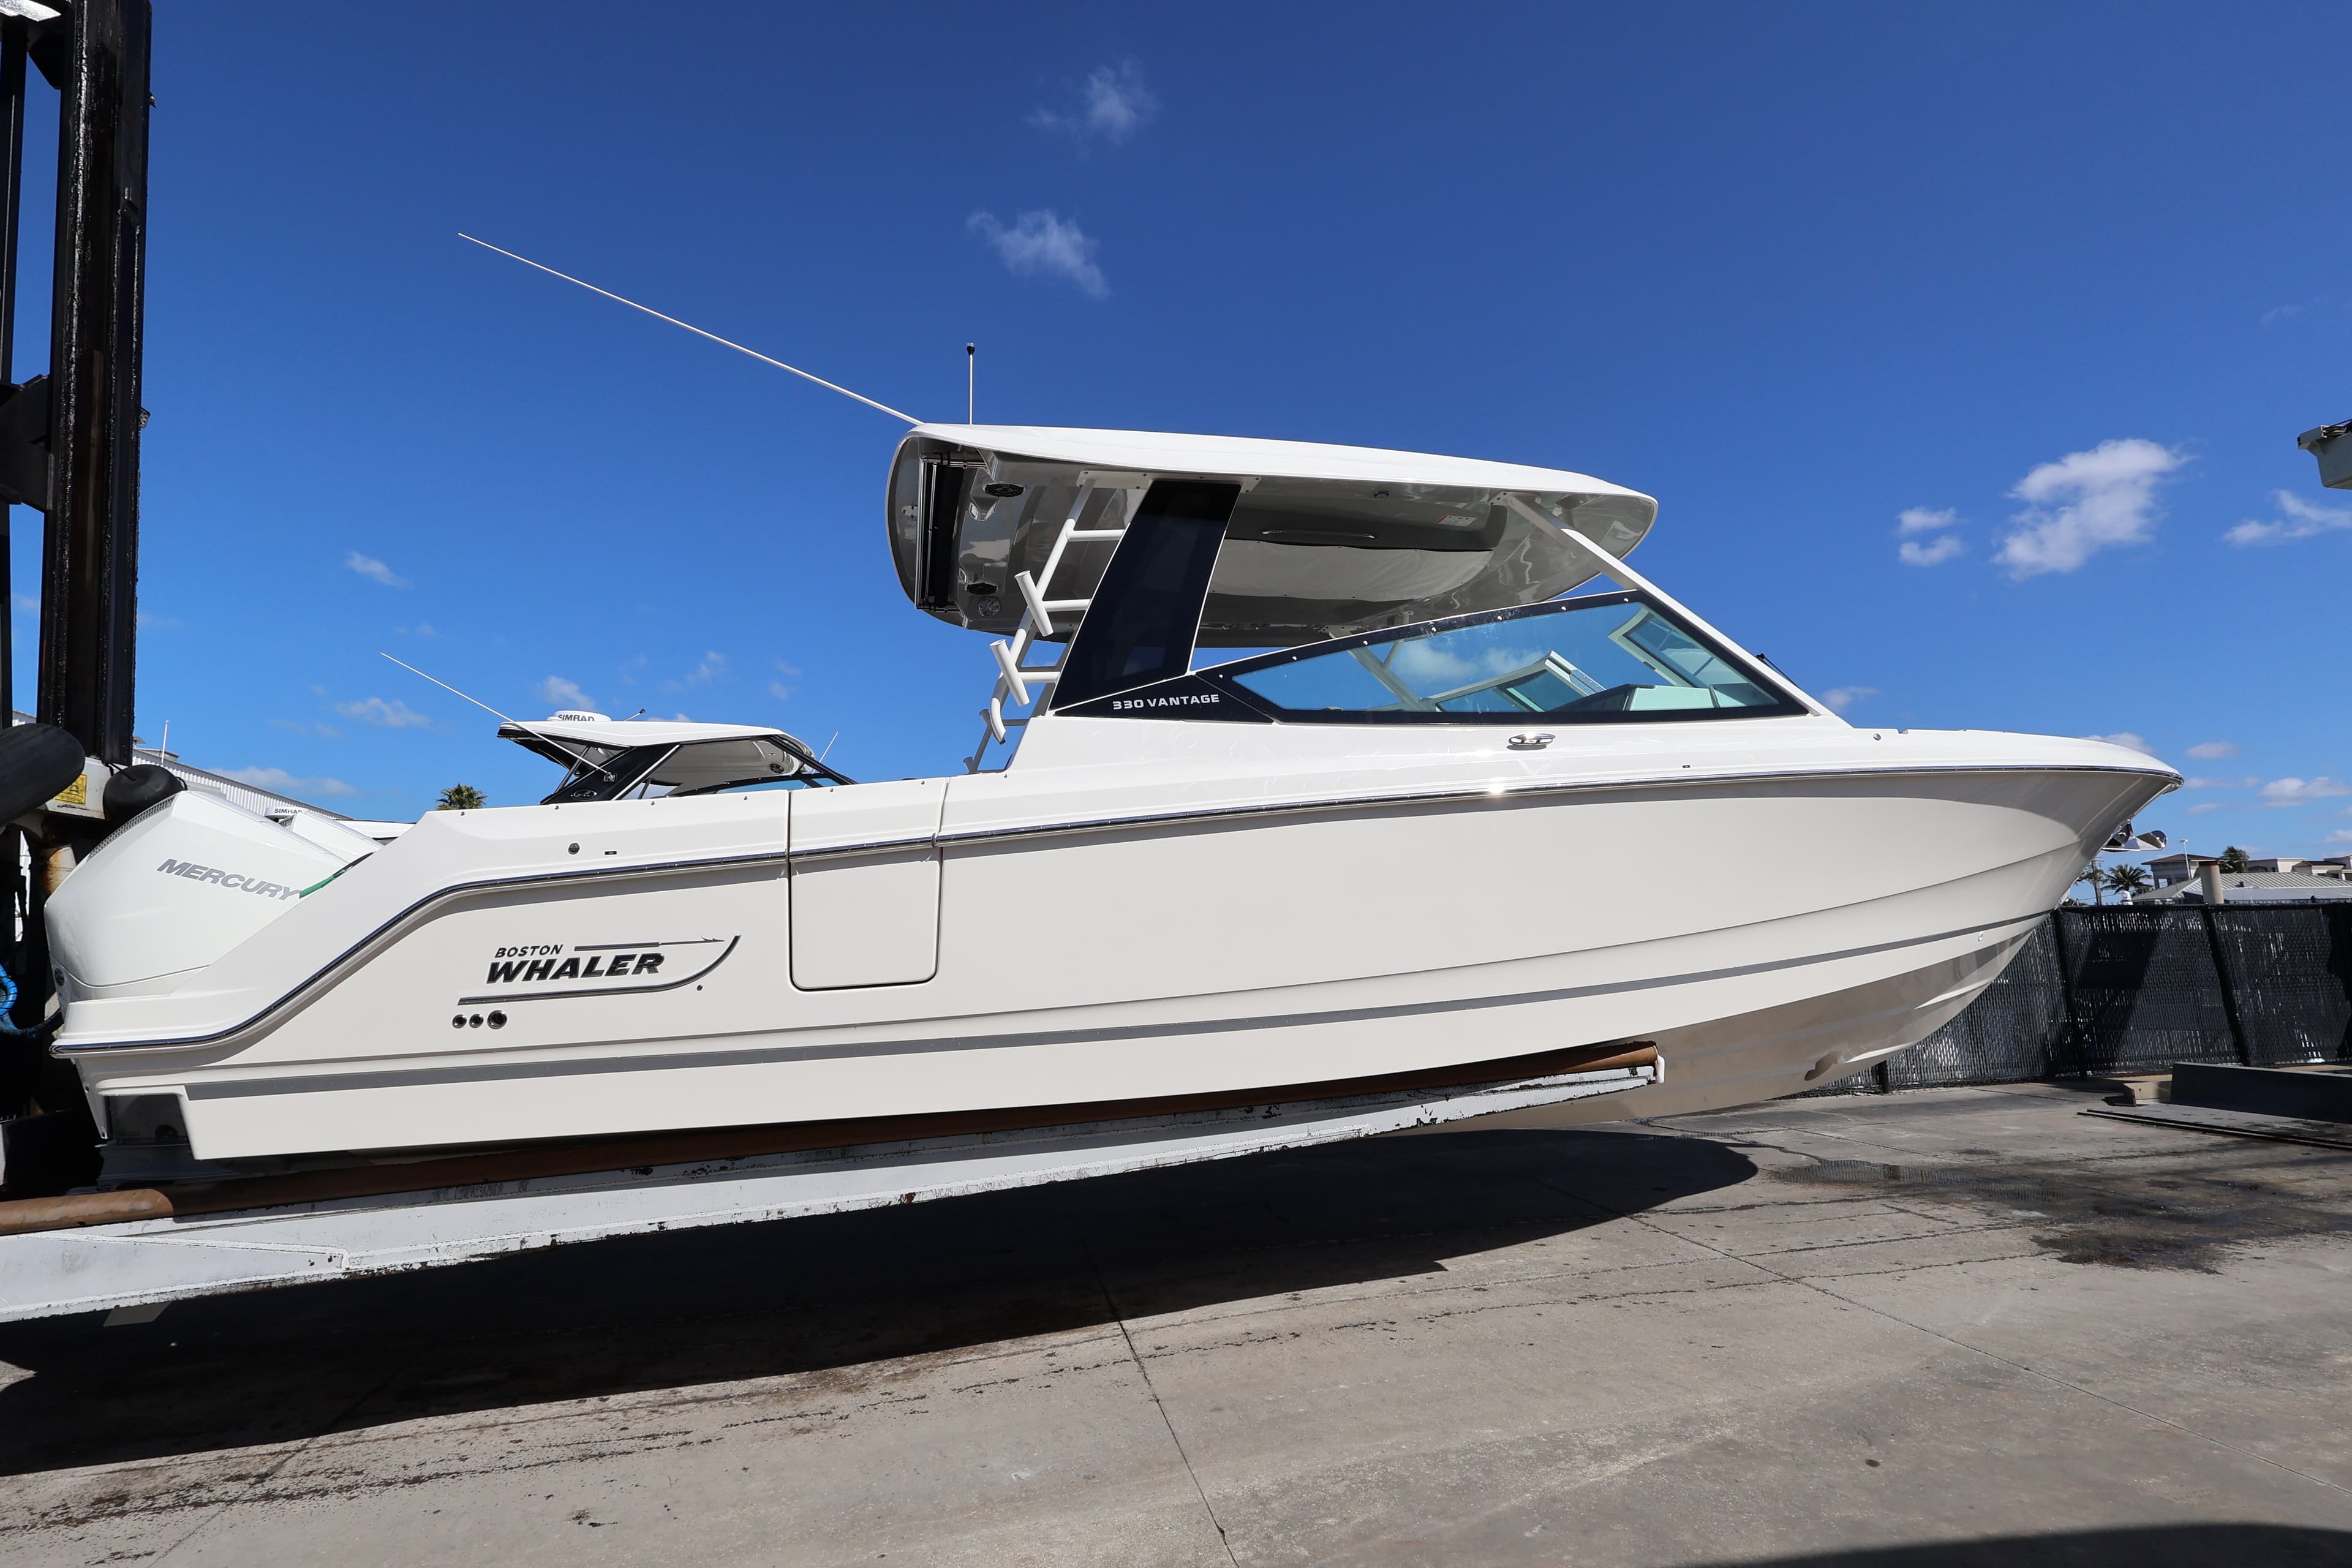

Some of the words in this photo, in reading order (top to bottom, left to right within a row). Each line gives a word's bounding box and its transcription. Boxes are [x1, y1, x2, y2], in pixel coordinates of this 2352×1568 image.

[1112, 699, 1144, 710] 330
[1147, 694, 1219, 707] VANTAGE
[157, 859, 301, 900] MERCURY
[494, 944, 564, 959] BOSTON
[486, 953, 665, 984] WHALER
